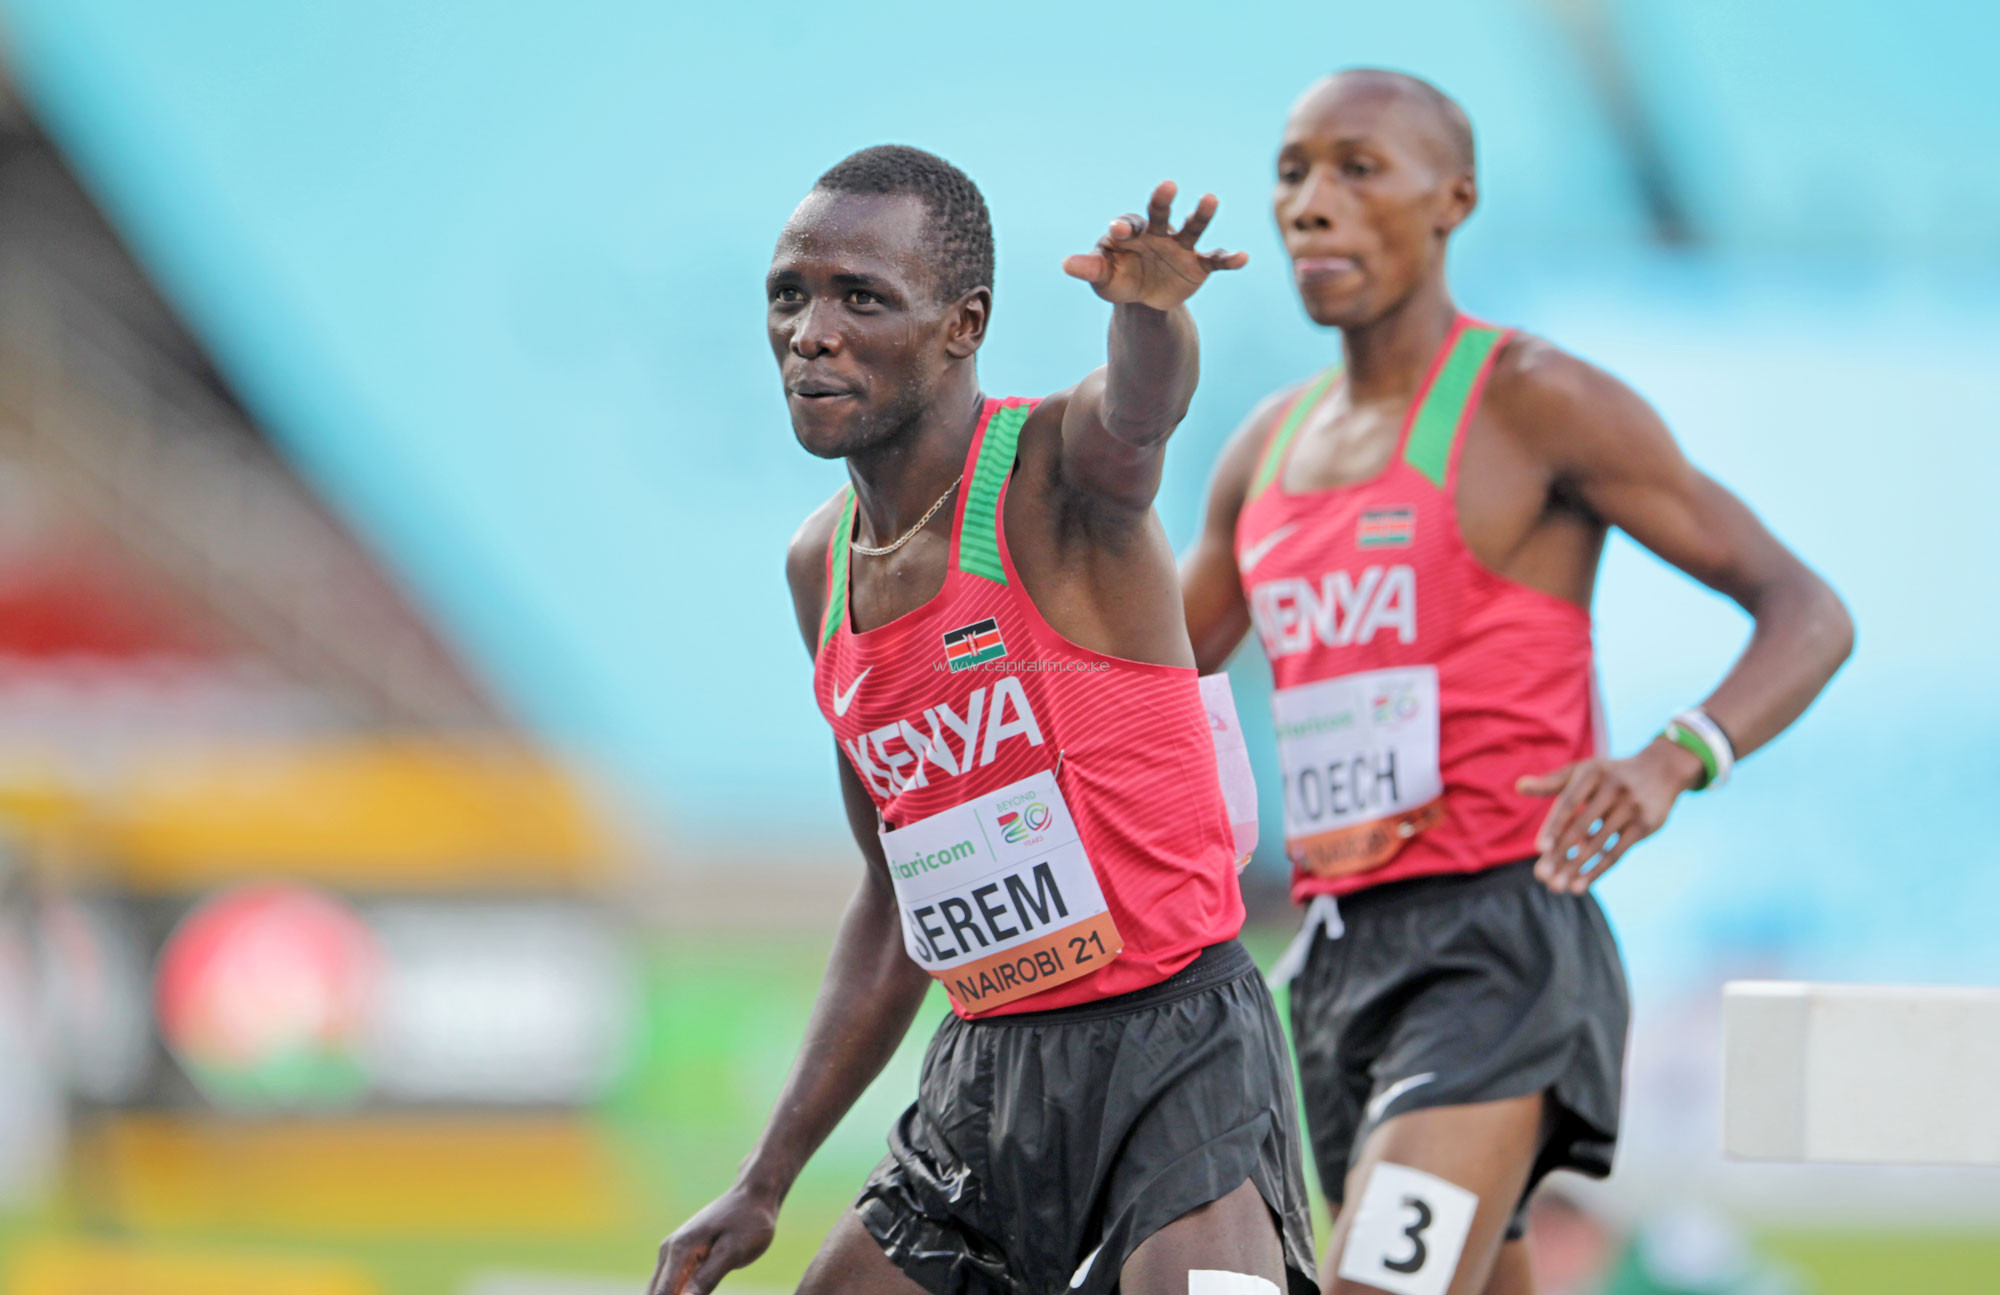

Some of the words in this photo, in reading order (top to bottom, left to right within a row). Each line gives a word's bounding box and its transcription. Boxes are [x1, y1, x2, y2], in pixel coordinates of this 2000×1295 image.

[845, 676, 1044, 799] KENYA
[996, 790, 1037, 813] BEYOND
[1283, 747, 1399, 827] OECH
[956, 947, 1065, 1003] NAIROBI
[1068, 930, 1106, 964] 21
[1383, 1196, 1432, 1274] 3
